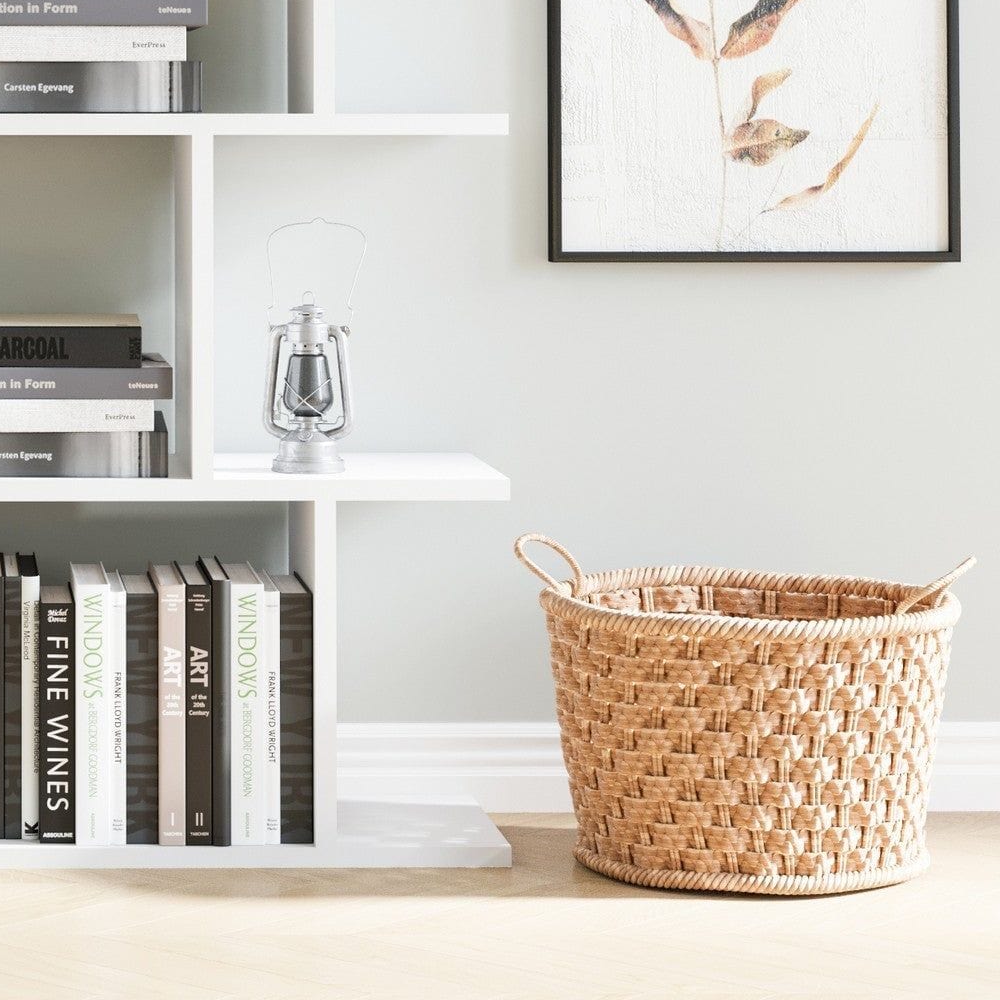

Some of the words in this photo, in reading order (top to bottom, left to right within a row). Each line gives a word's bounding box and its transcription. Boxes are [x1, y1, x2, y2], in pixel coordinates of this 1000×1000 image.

[27, 1, 39, 14] in
[44, 2, 77, 14] Form
[4, 83, 35, 92] Carsten
[38, 83, 74, 94] Egevang
[10, 378, 21, 390] in
[25, 379, 56, 390] Form
[20, 450, 52, 460] Egevang
[83, 593, 103, 699] WINDOWS
[237, 593, 257, 699] WINDOWS
[47, 636, 68, 700] FINE
[163, 646, 182, 687] ART
[190, 645, 208, 687] ART
[268, 671, 276, 698] FRANK
[268, 701, 276, 728] LLOYD
[46, 714, 69, 811] WINES
[114, 729, 122, 763] WRIGHT
[268, 729, 276, 763] WRIGHT
[24, 821, 39, 834] K
